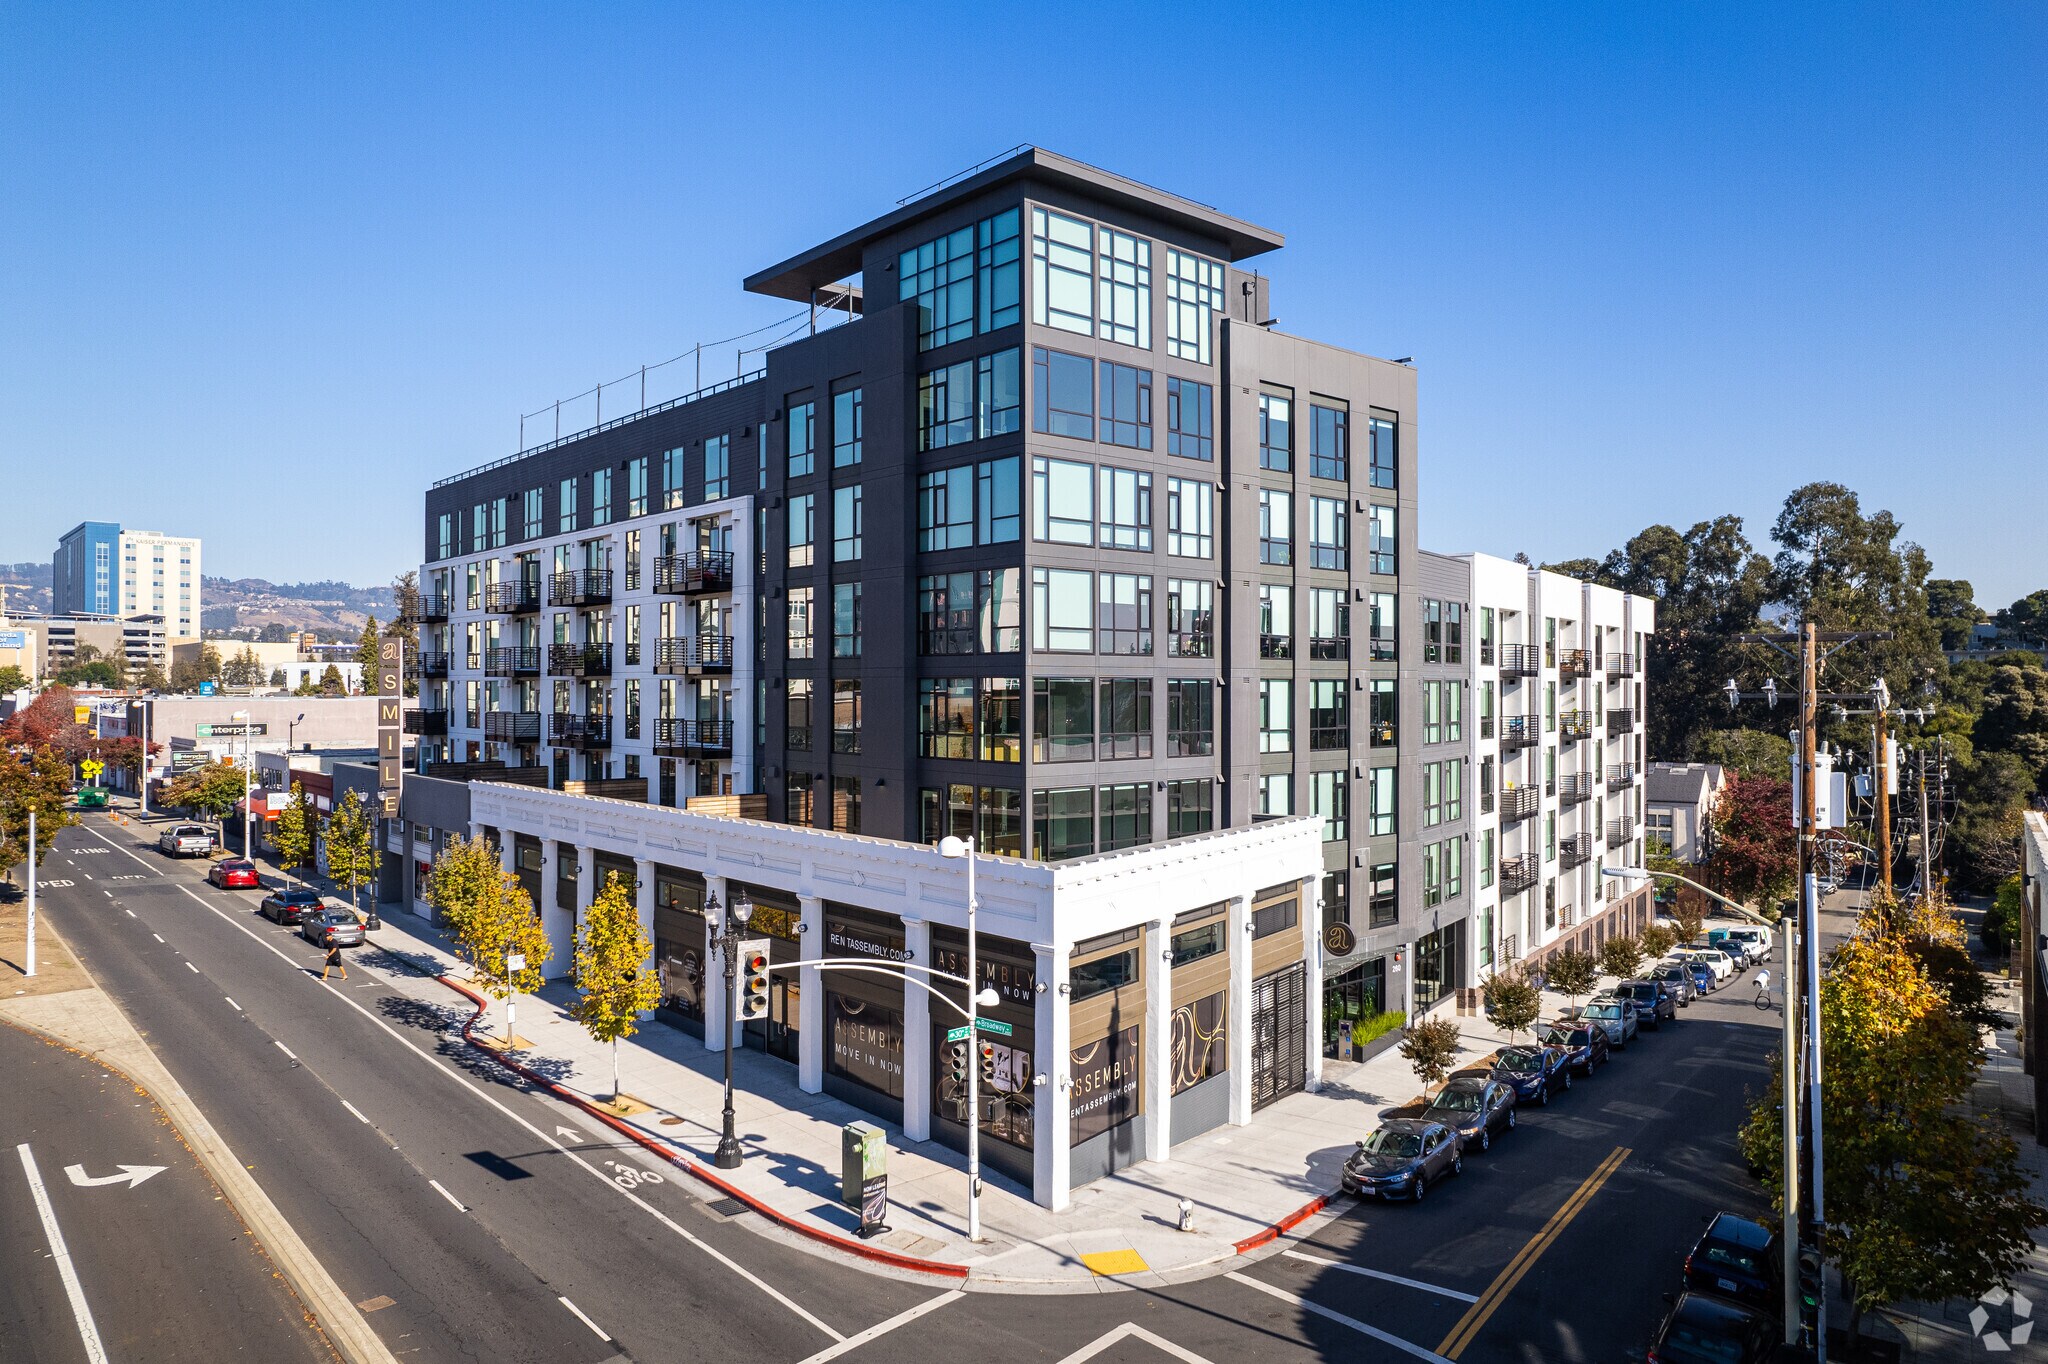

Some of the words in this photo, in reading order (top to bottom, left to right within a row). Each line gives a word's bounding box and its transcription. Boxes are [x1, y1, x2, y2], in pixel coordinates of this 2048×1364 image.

[200, 726, 262, 735] enterprise
[37, 879, 75, 889] PED
[1003, 985, 1030, 1001] NOW
[980, 1019, 1006, 1034] Broadway
[835, 1017, 901, 1053] ASSEMBLY
[835, 1042, 860, 1061] MOVE
[865, 1053, 875, 1066] IN
[880, 1059, 902, 1075] NOW
